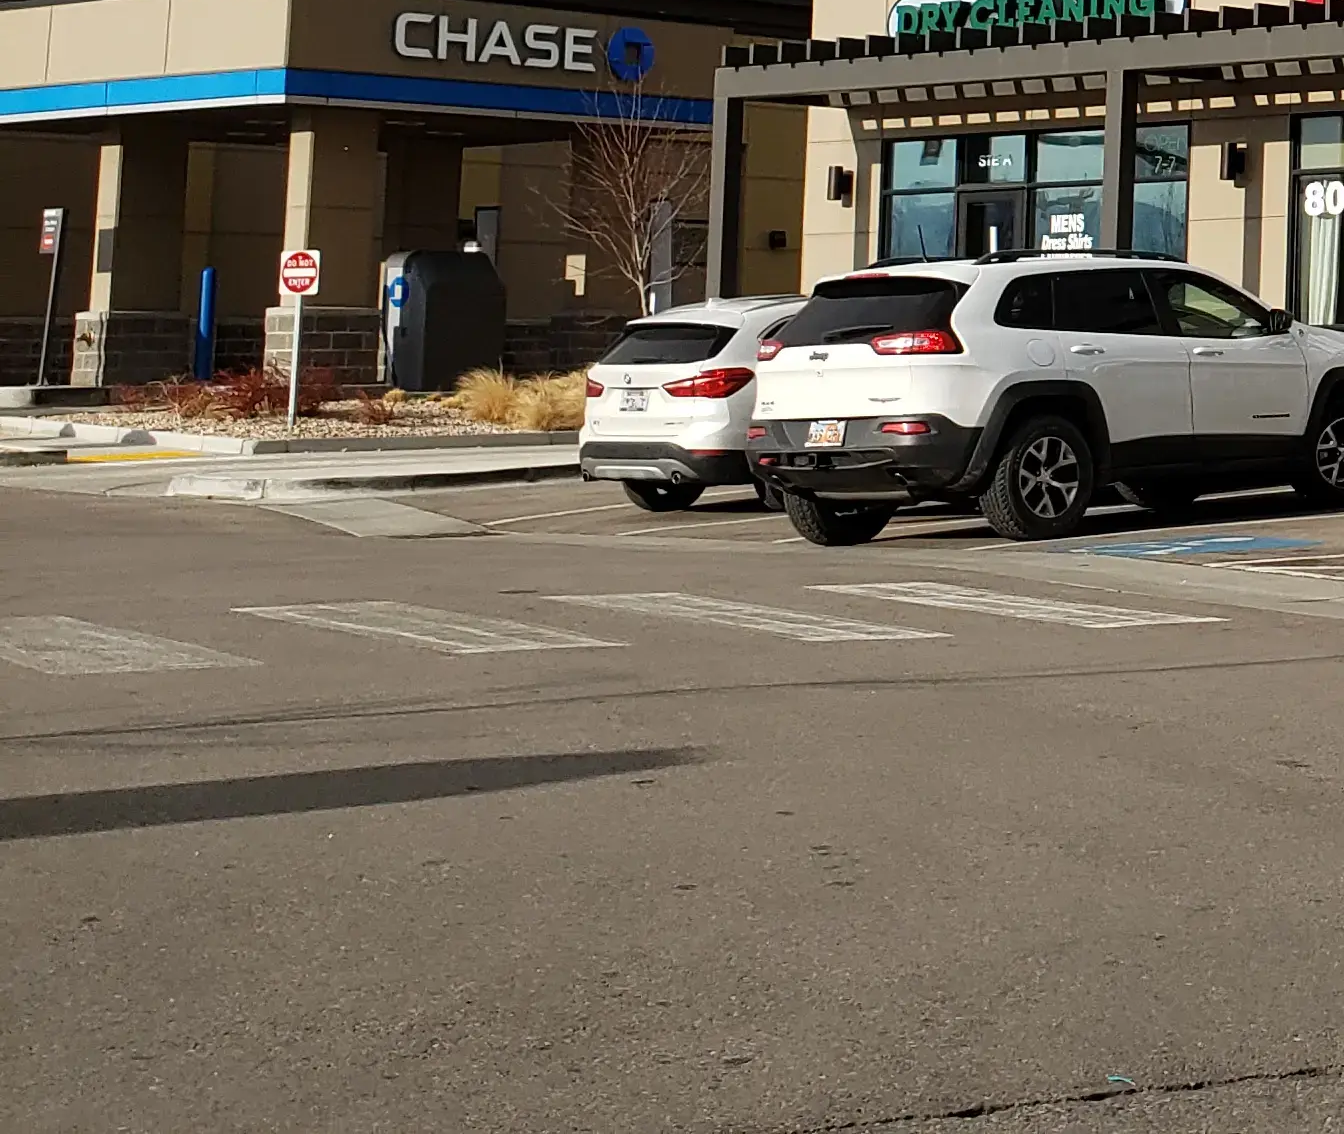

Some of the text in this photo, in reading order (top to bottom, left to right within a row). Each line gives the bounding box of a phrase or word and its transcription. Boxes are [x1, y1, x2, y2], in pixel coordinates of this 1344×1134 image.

[896, 0, 964, 35] DRY
[395, 12, 599, 72] CHASE
[1002, 154, 1013, 166] A
[1050, 213, 1085, 233] MENS
[1041, 232, 1093, 250] Dress Shirts
[287, 259, 313, 267] DO NOT
[288, 278, 310, 286] ENTER
